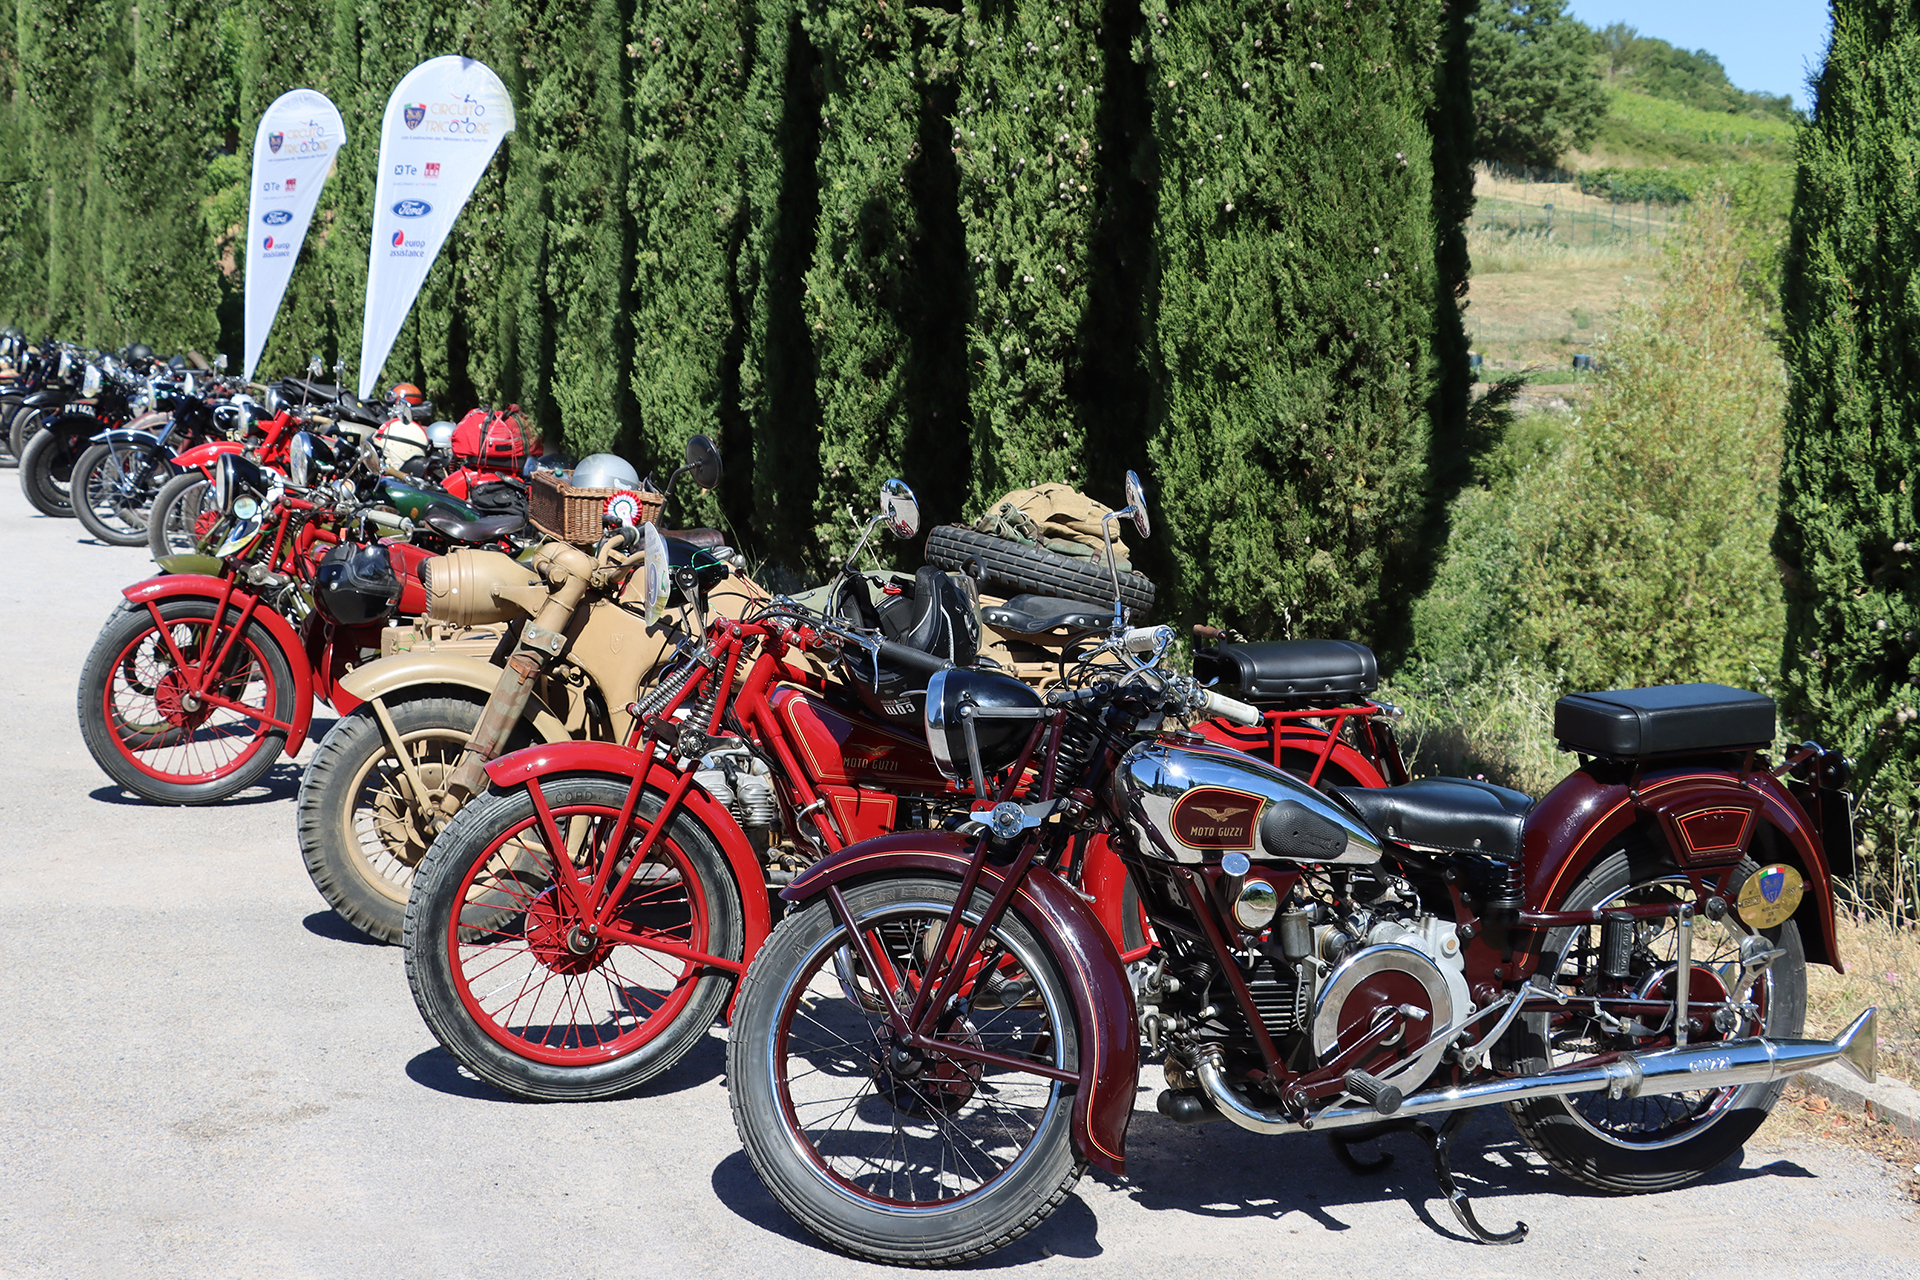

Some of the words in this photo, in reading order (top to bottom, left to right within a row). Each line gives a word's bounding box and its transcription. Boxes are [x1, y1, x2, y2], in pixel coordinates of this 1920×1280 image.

[430, 102, 485, 117] CIRCUITO
[425, 120, 491, 134] TRICOLORE
[404, 240, 426, 249] europ
[390, 249, 425, 258] assistance
[842, 756, 869, 769] MOTO
[871, 759, 898, 771] GUZZI
[555, 790, 593, 804] CORD
[1190, 826, 1215, 837] MOTO
[1217, 827, 1244, 837] GUZZI
